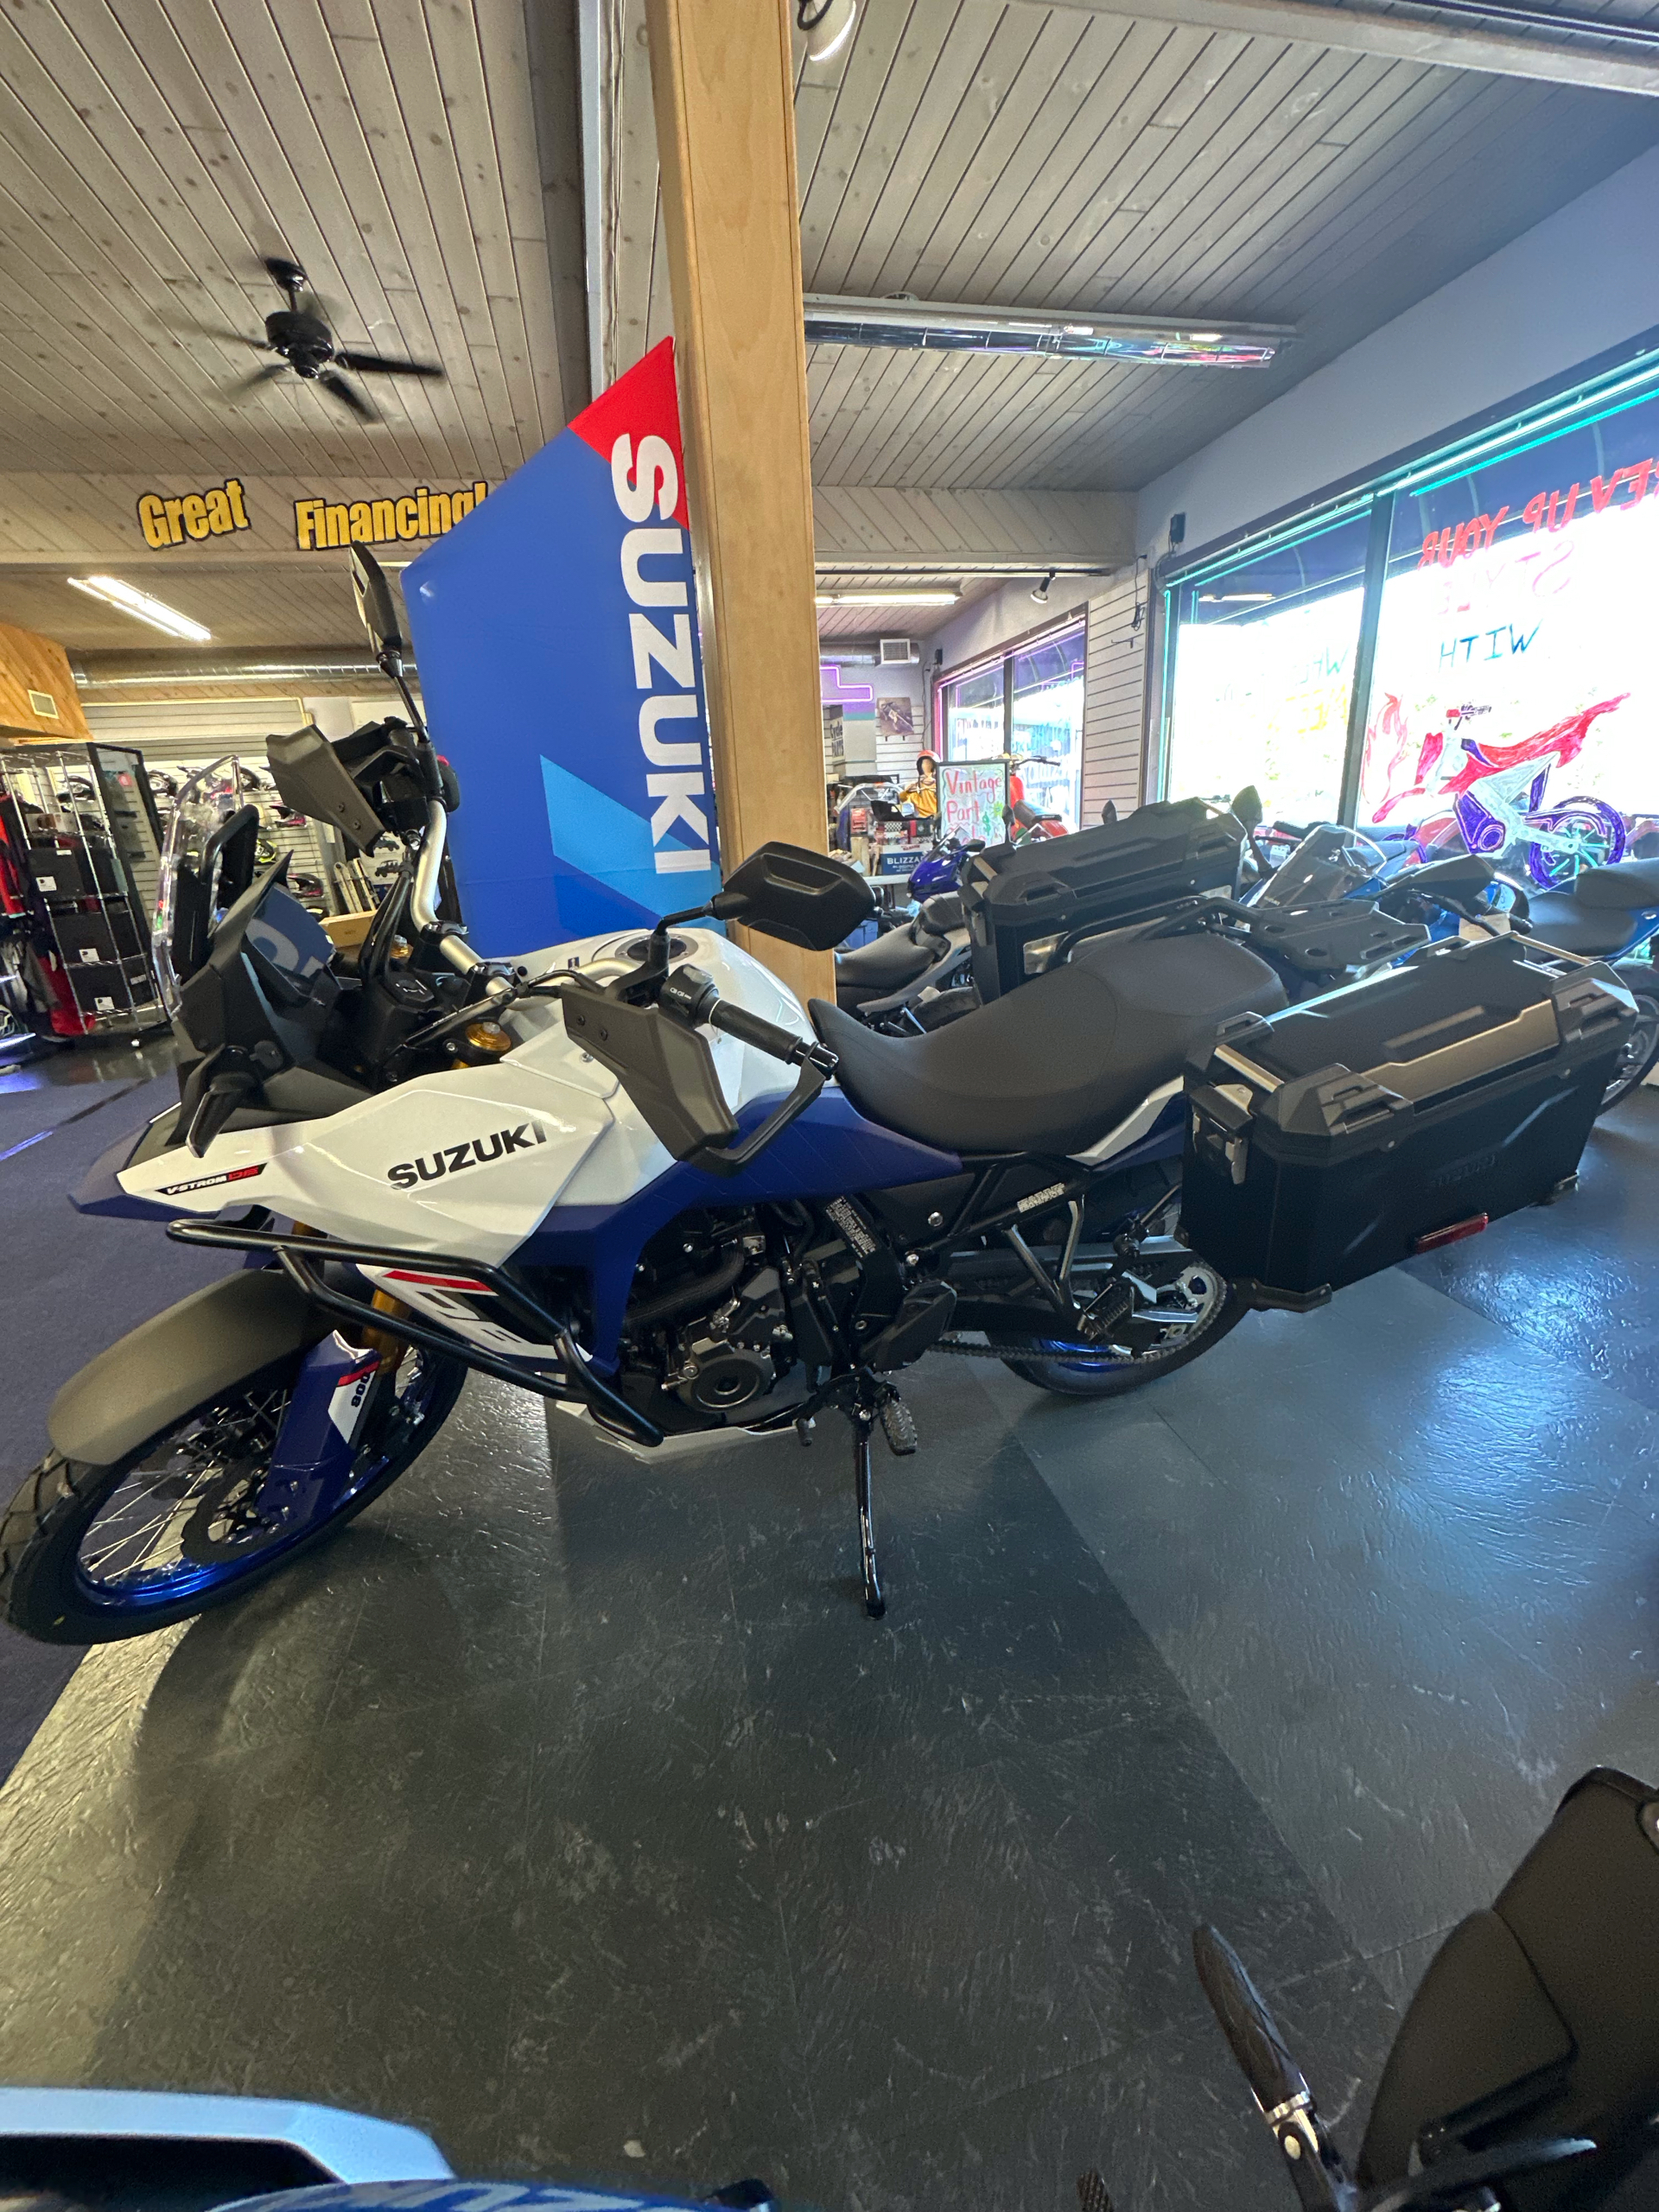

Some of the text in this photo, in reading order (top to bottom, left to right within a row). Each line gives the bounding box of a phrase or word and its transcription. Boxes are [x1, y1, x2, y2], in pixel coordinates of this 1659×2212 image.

[137, 478, 251, 550] Great
[611, 433, 711, 874] SUZUKI
[945, 771, 1002, 804] Vintage
[946, 800, 980, 823] Part
[387, 1120, 547, 1190] SUZUKI
[166, 1174, 227, 1194] V-STROM
